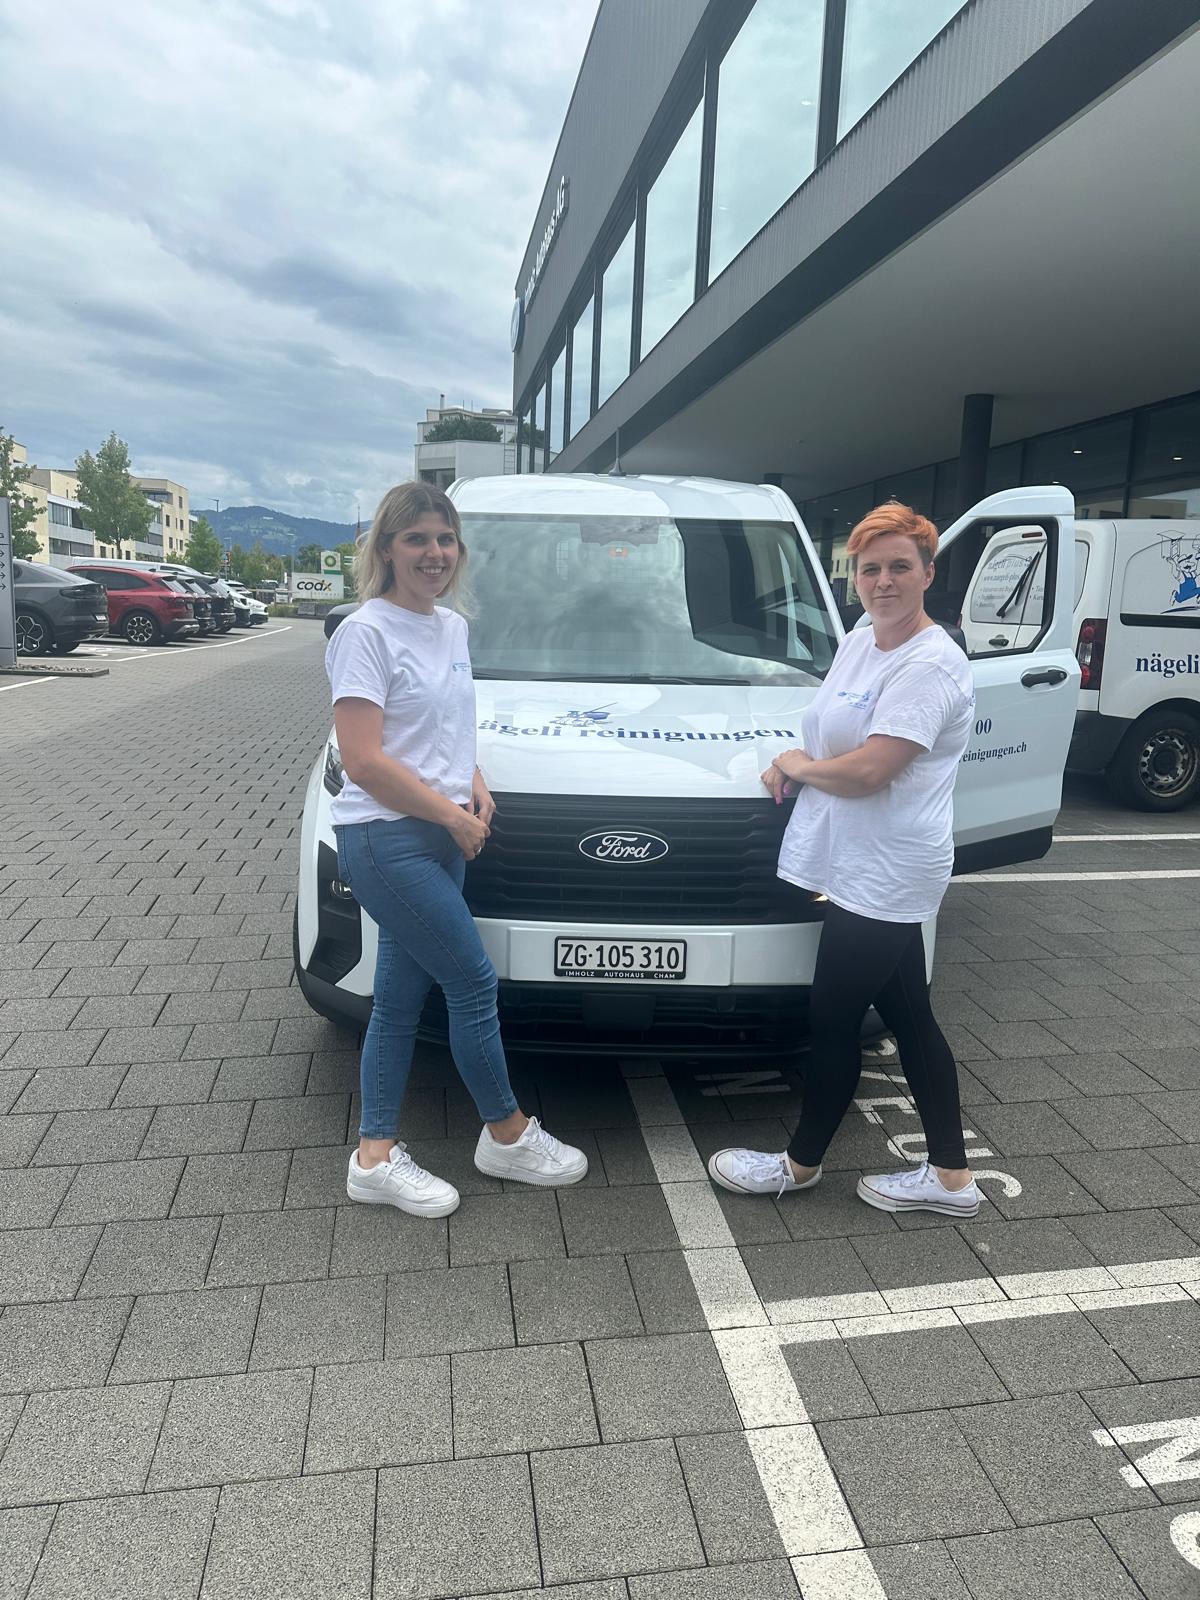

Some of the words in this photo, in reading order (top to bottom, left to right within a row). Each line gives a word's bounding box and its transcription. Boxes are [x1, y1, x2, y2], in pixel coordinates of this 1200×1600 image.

[1135, 652, 1200, 679] nägeli
[478, 720, 561, 737] ägeli
[580, 727, 795, 742] reinigungen
[975, 718, 992, 736] 00
[959, 741, 1027, 763] reinigungen.ch
[596, 835, 652, 858] Ford
